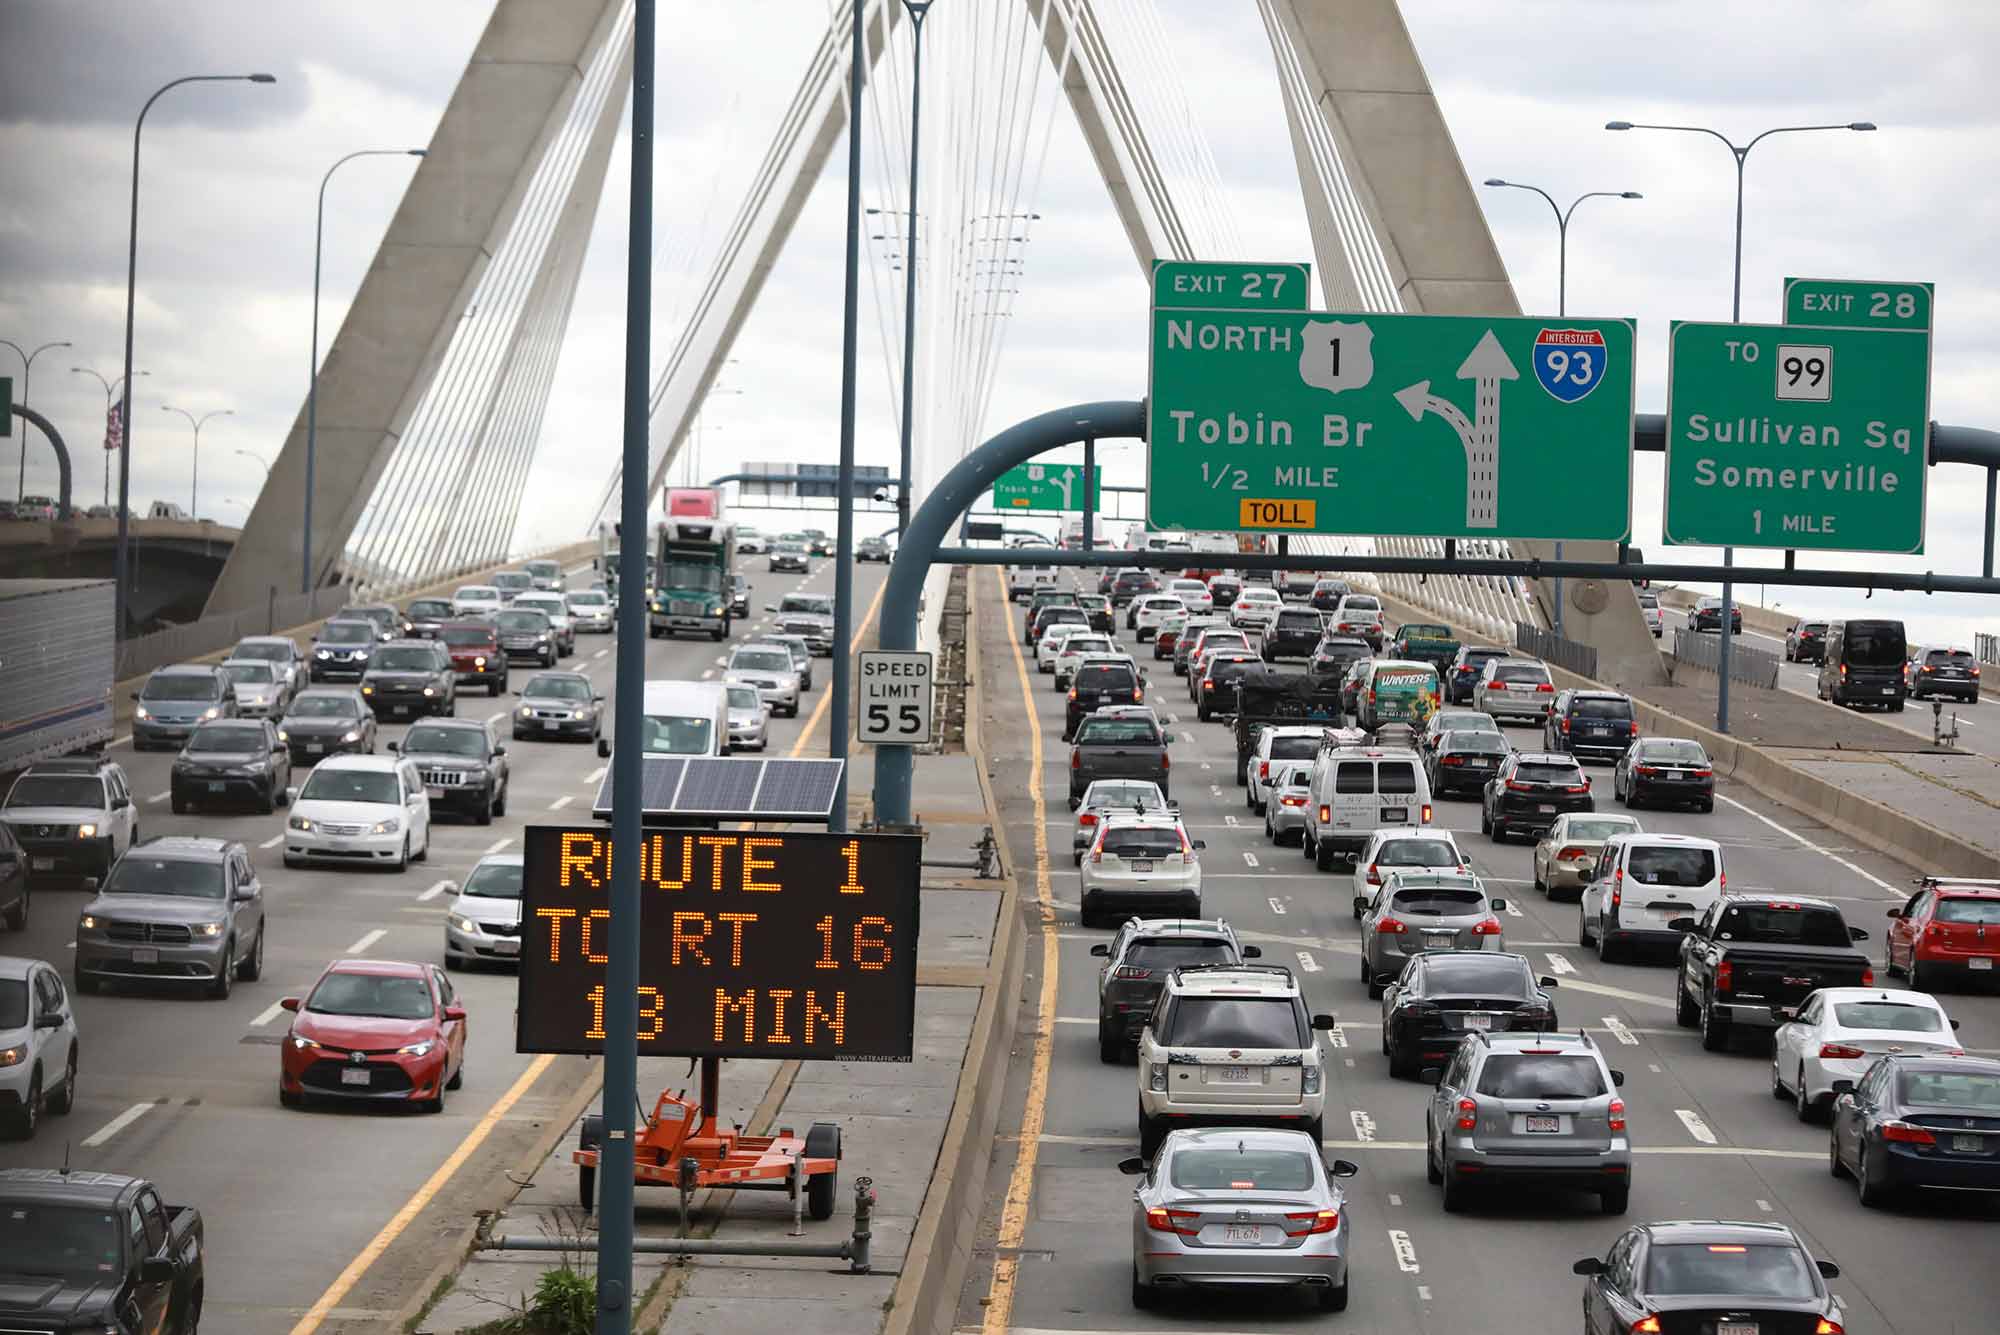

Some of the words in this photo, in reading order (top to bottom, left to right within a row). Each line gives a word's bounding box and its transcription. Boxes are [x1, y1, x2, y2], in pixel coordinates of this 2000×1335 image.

[1174, 274, 1227, 294] EXIT
[1241, 272, 1287, 298] 27
[1803, 293, 1854, 312] EXIT
[1869, 291, 1916, 318] 28
[1167, 319, 1292, 352] NORTH
[1545, 332, 1595, 344] INTERSTATE
[1330, 337, 1341, 377] 1
[1724, 341, 1760, 362] TO
[1546, 349, 1594, 386] 93
[1783, 356, 1826, 388] 99
[1169, 409, 1293, 447] Tobin
[1322, 413, 1374, 447] Br
[1685, 413, 1841, 447] Sullivan
[1863, 420, 1913, 455] Sq
[1201, 461, 1249, 490] 1/2
[1274, 466, 1340, 489] MILE
[1693, 457, 1900, 493] Somerville
[1249, 502, 1307, 524] TOLL
[1752, 509, 1763, 534] 1
[1783, 514, 1836, 533] MILE
[864, 662, 928, 677] SPEED
[869, 684, 921, 698] LIMIT
[867, 704, 922, 734] 55
[560, 832, 784, 892] RUTE
[839, 839, 865, 894] 1
[671, 911, 759, 967] RT
[814, 914, 893, 970] 16
[713, 988, 845, 1045] MIN
